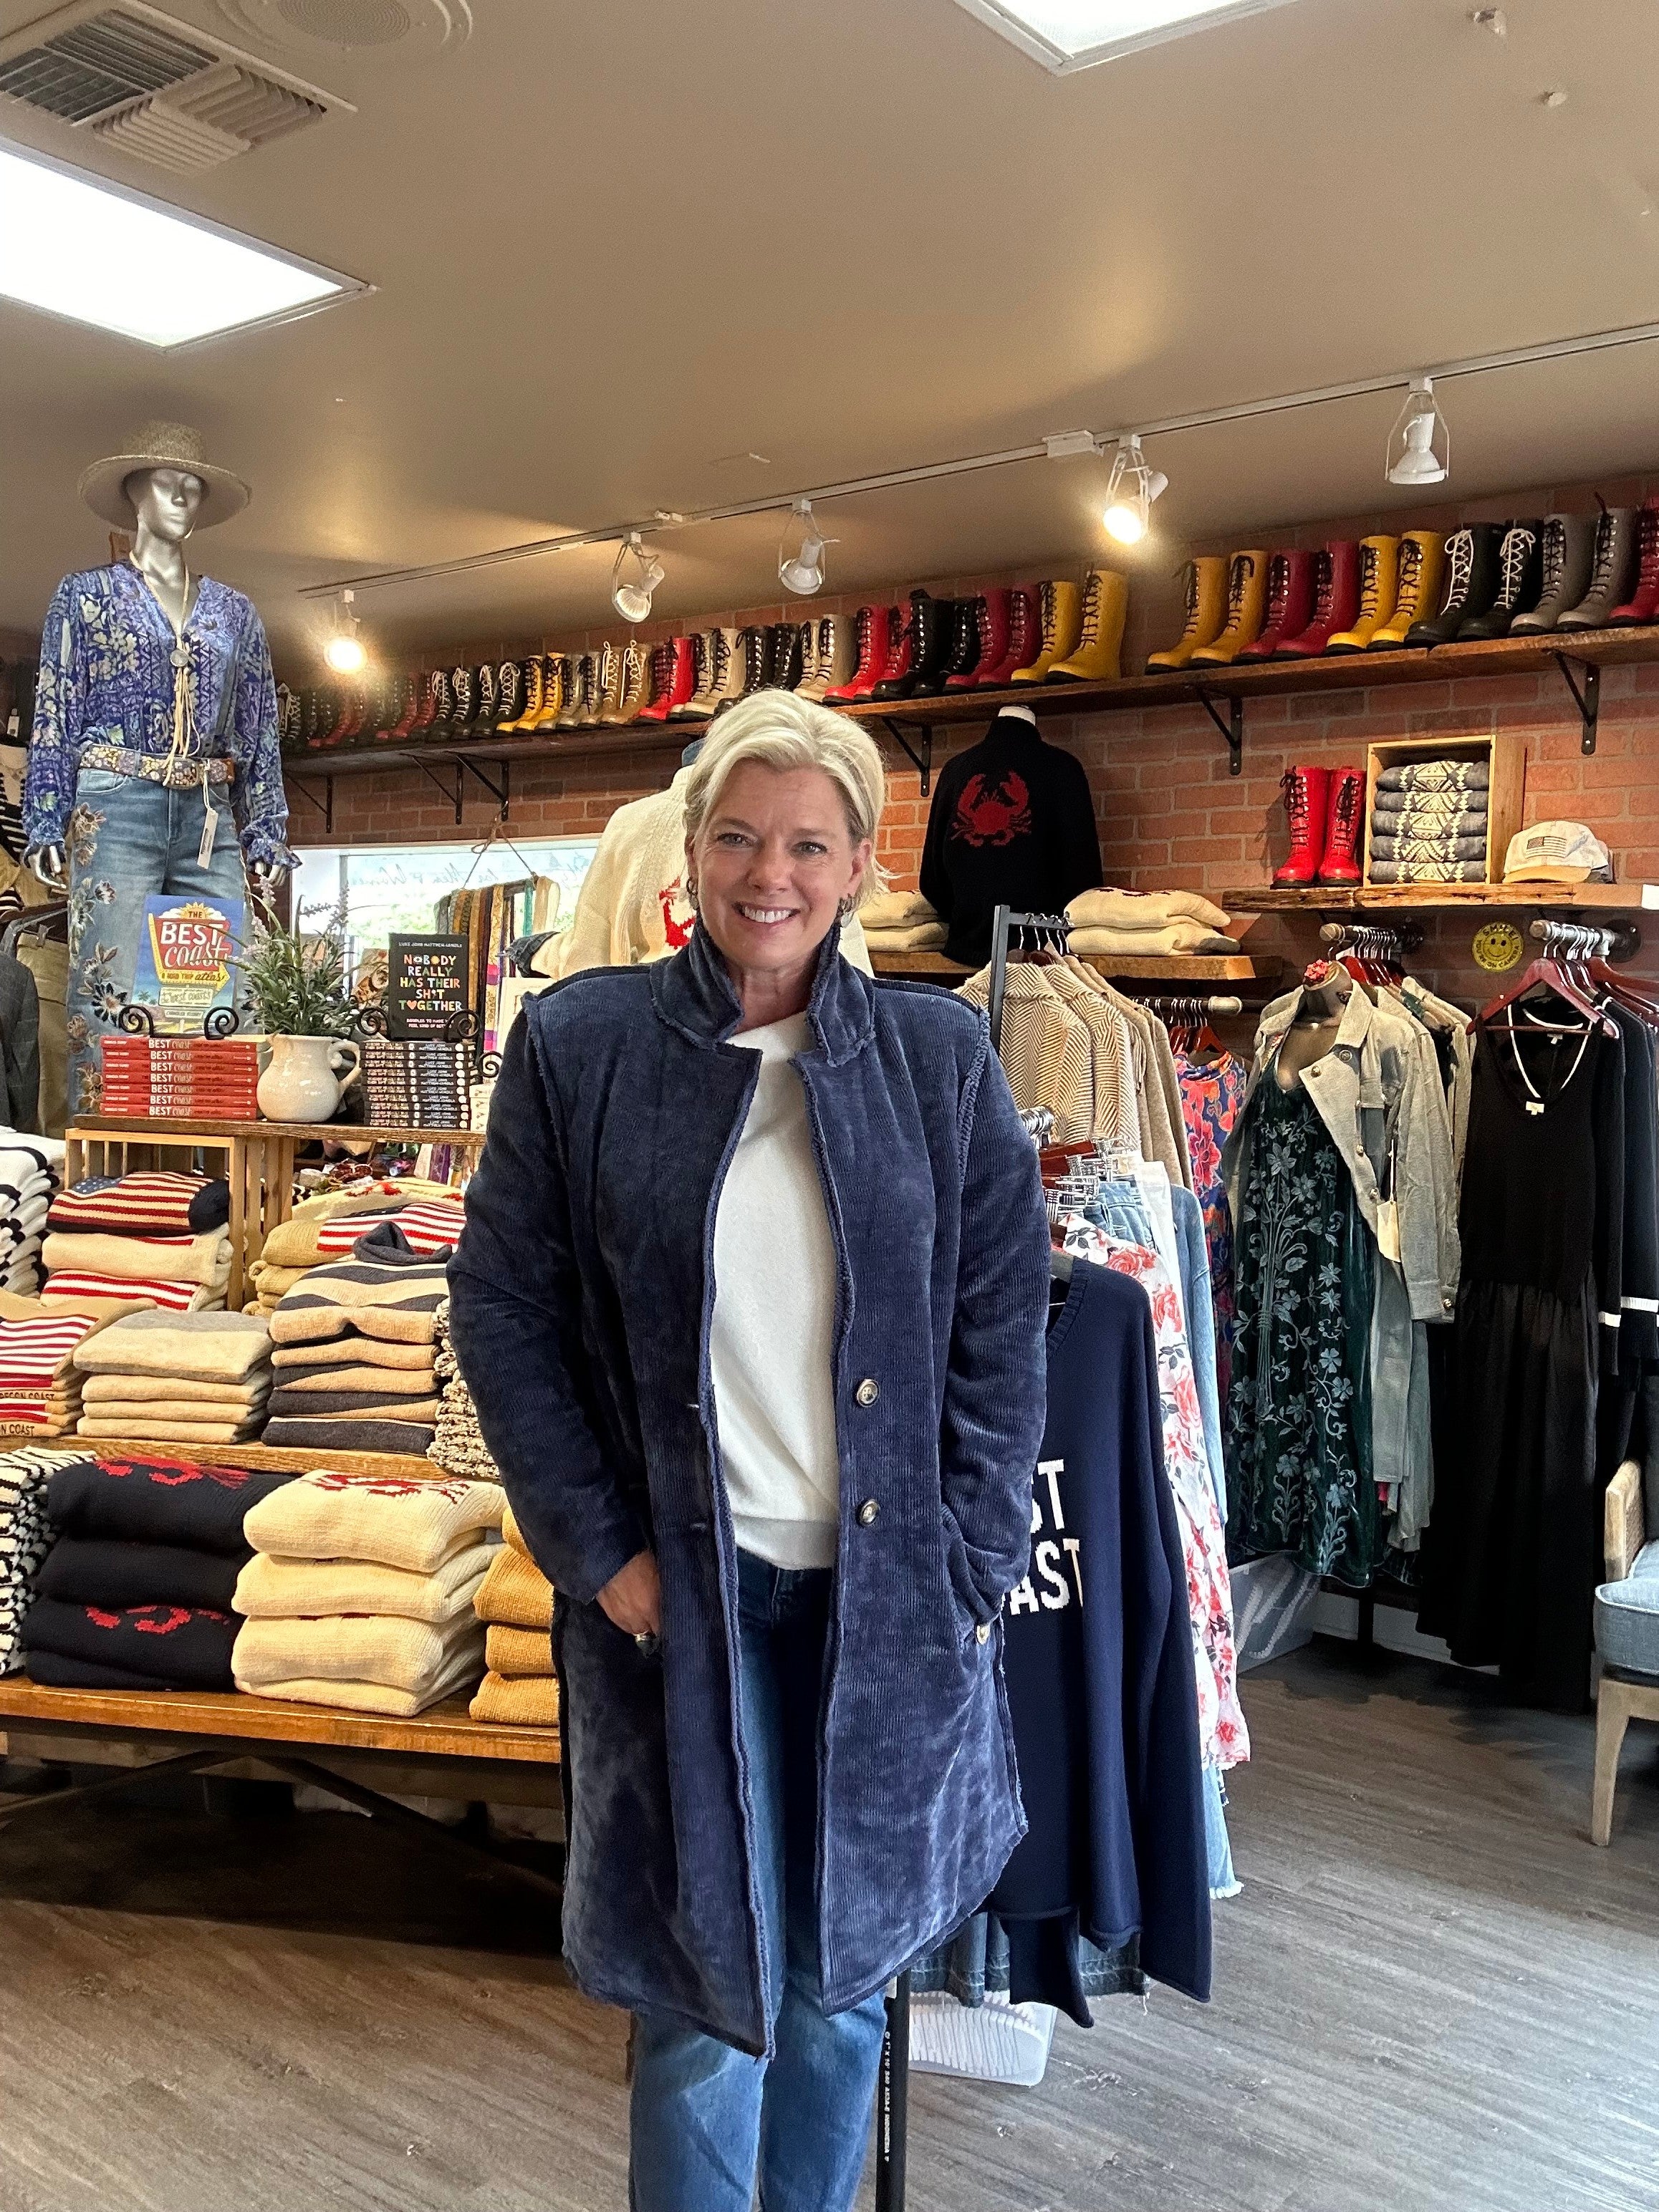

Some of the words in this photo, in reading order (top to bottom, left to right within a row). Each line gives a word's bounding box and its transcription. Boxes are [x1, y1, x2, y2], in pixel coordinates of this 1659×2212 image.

[160, 921, 224, 946] BEST
[408, 966, 453, 976] REALLY
[400, 976, 423, 988] HAS
[427, 977, 461, 989] THEIR
[148, 1039, 170, 1049] BEST
[150, 1050, 173, 1060] BEST
[150, 1062, 173, 1072] BEST
[150, 1073, 173, 1082] BEST
[151, 1084, 173, 1093] BEST
[150, 1095, 172, 1105] BEST
[149, 1105, 172, 1116] BEST
[9, 1423, 34, 1437] COAST
